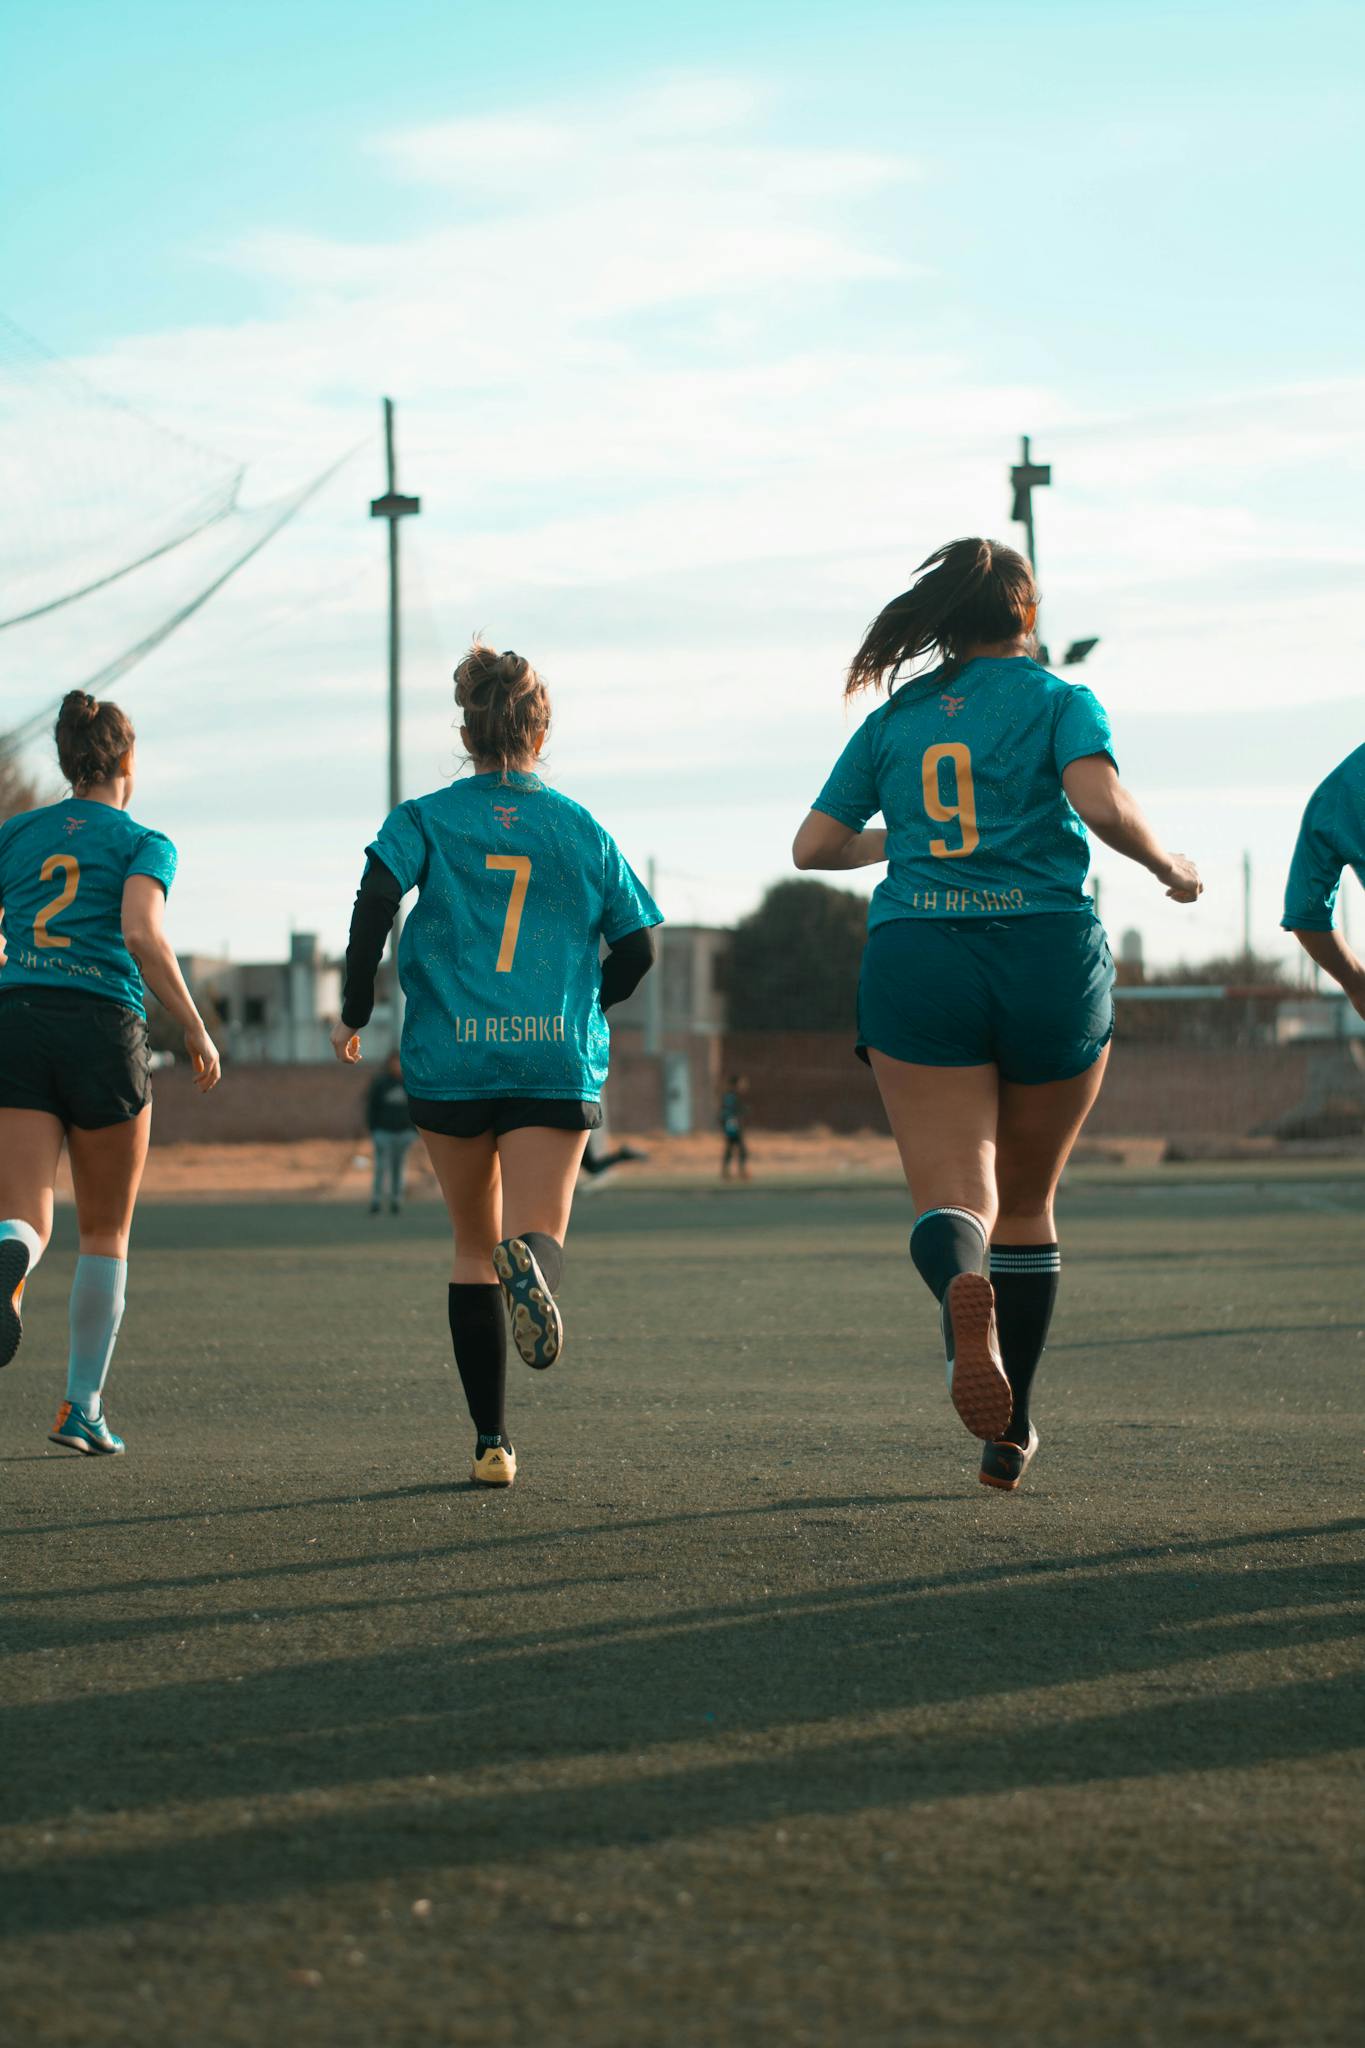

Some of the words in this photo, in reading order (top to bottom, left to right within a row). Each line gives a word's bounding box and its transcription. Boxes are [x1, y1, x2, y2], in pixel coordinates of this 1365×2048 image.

[922, 742, 980, 858] 9
[33, 854, 80, 948] 2
[486, 855, 532, 972] 7
[456, 1016, 477, 1042] LA
[486, 1015, 565, 1042] RESAKA
